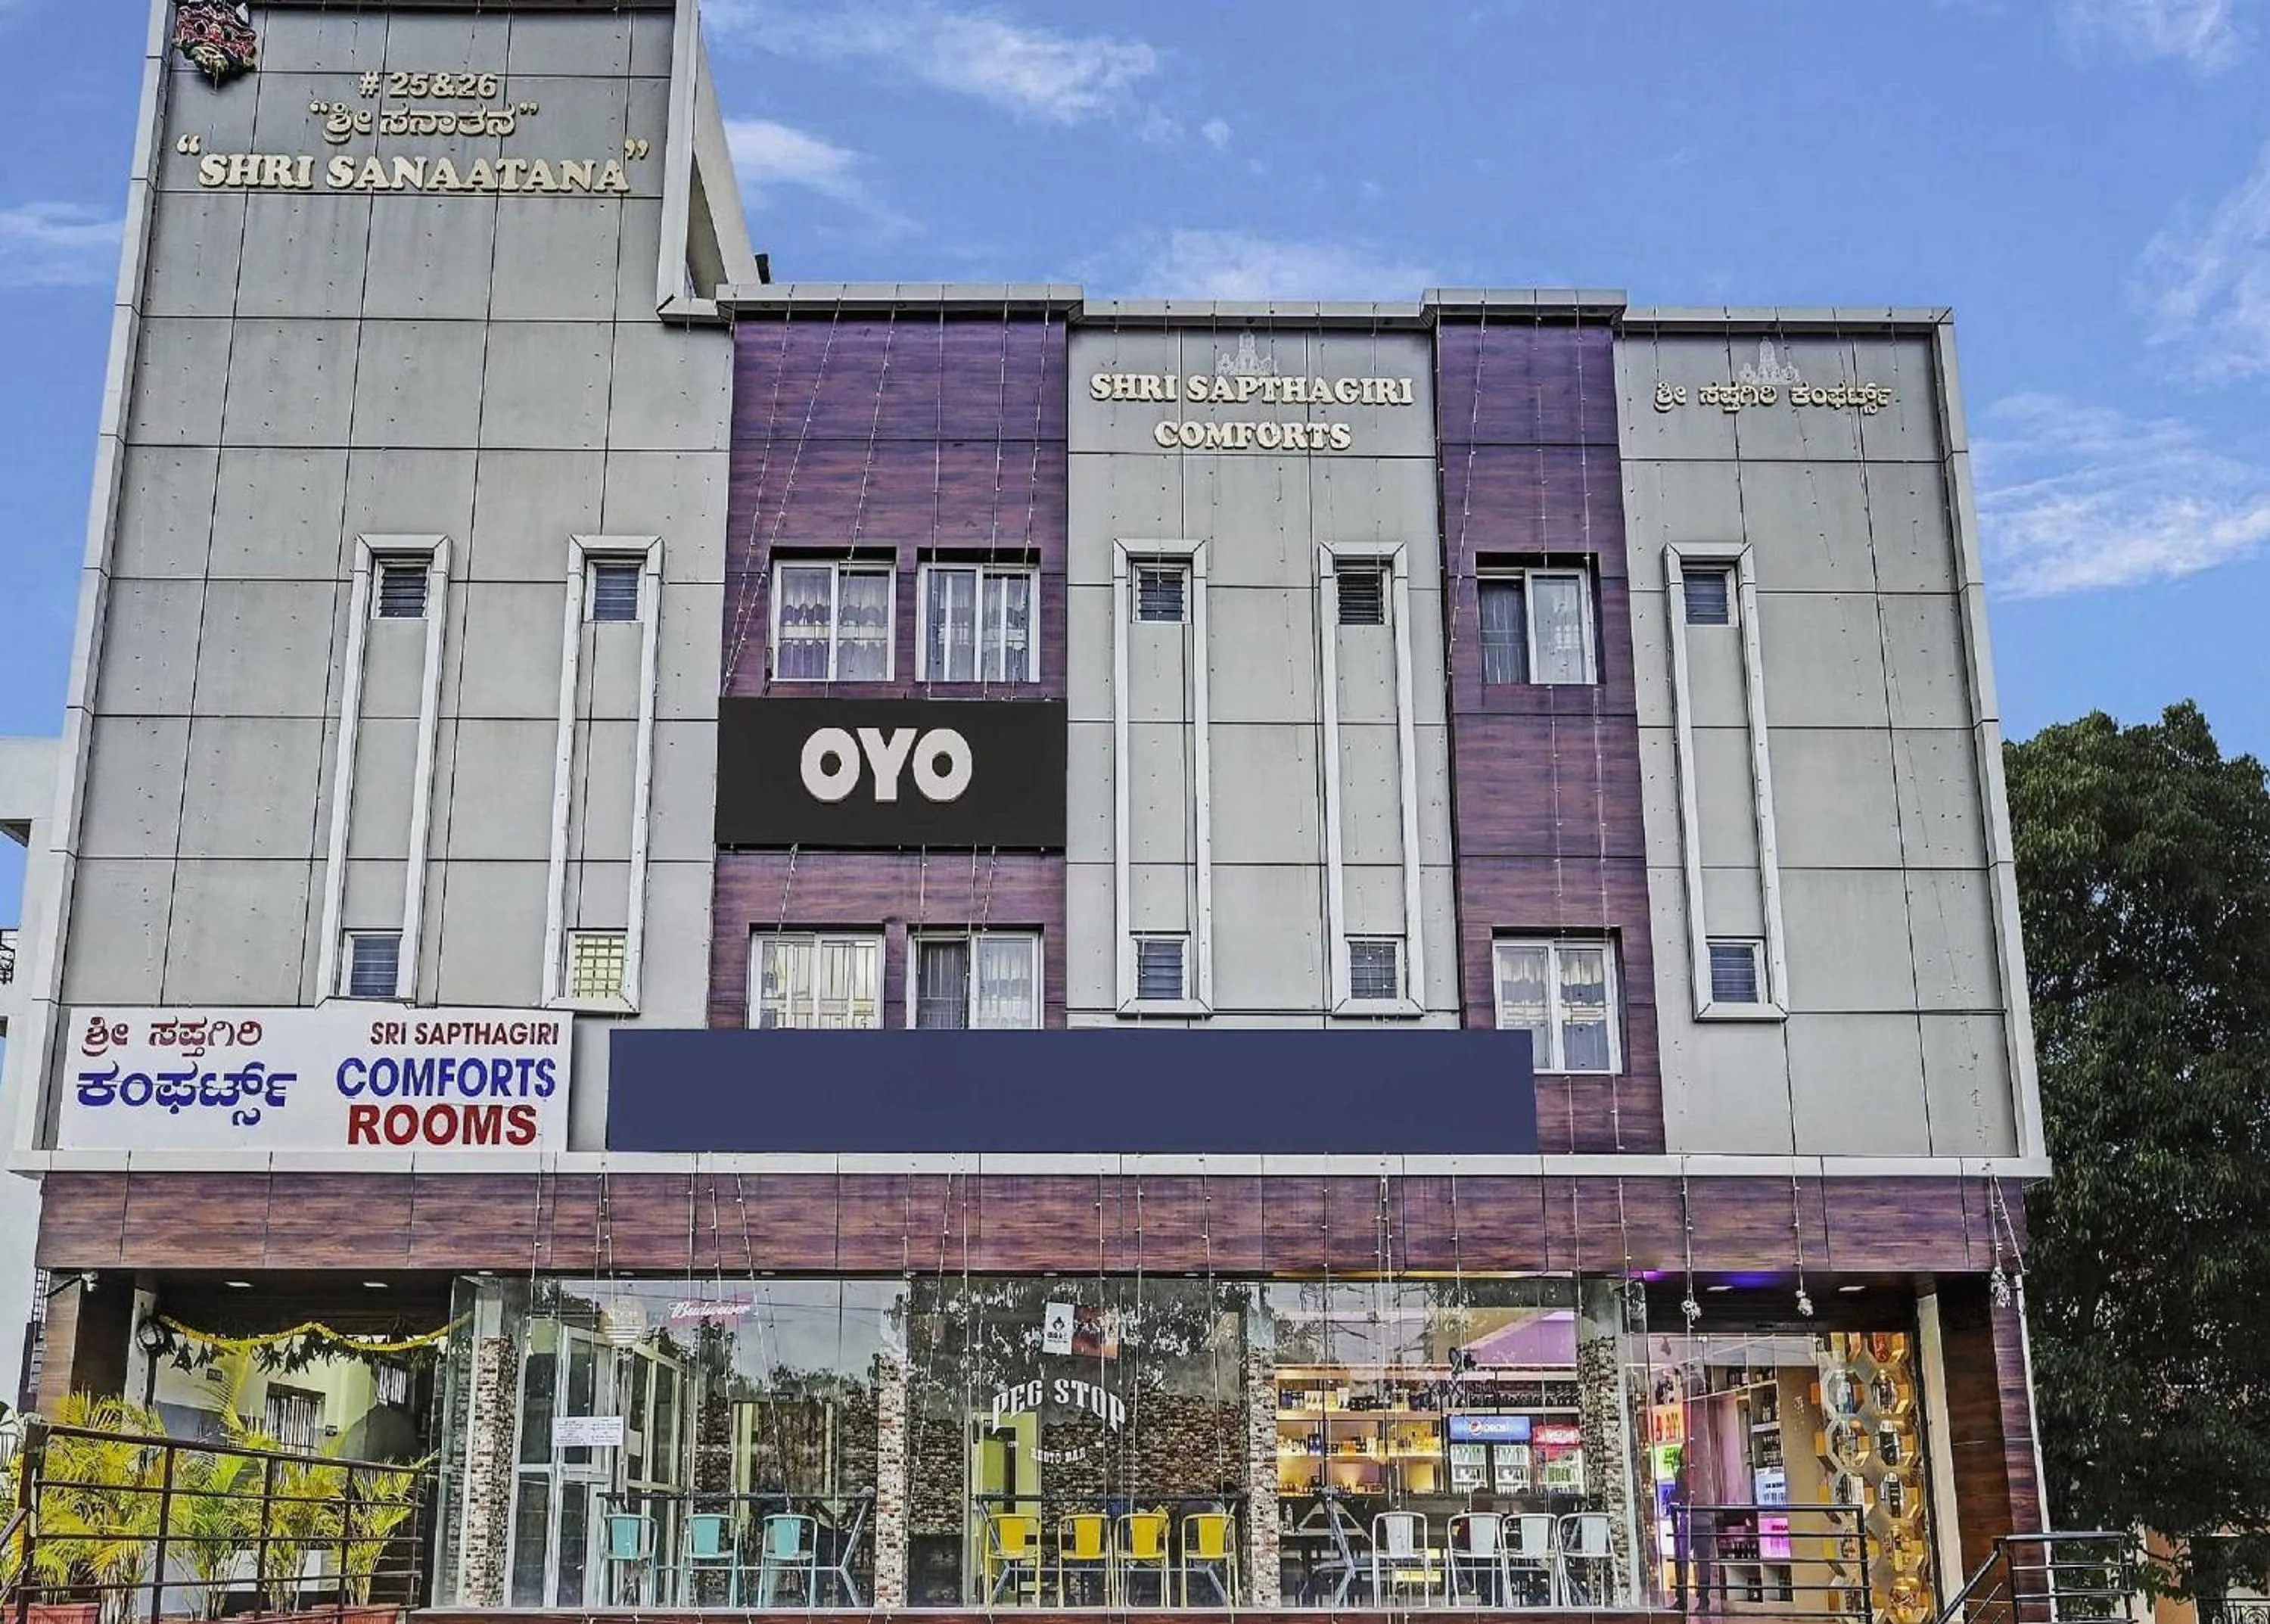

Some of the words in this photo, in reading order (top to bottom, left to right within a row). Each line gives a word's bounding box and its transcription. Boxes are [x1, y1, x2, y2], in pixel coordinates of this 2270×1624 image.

[359, 70, 379, 97] #
[388, 72, 499, 97] 25&26
[1090, 373, 1177, 401] SHRI
[1186, 375, 1414, 405] SAPTHAGIRI
[1654, 381, 1687, 412] ಶ್ರೀ
[1154, 422, 1353, 450] COMFORTS
[801, 727, 972, 803] OYO
[81, 1016, 129, 1056] ಶ್ರೀ
[149, 1016, 263, 1057] ಸಪ್ತಗಿರಿ
[370, 1022, 407, 1045] SRI
[414, 1022, 559, 1046] SAPTHAGIRI
[337, 1058, 556, 1100] COMFORTS
[347, 1104, 537, 1146] ROOMS
[991, 1380, 1043, 1435] PEG
[1054, 1378, 1126, 1434] STOP
